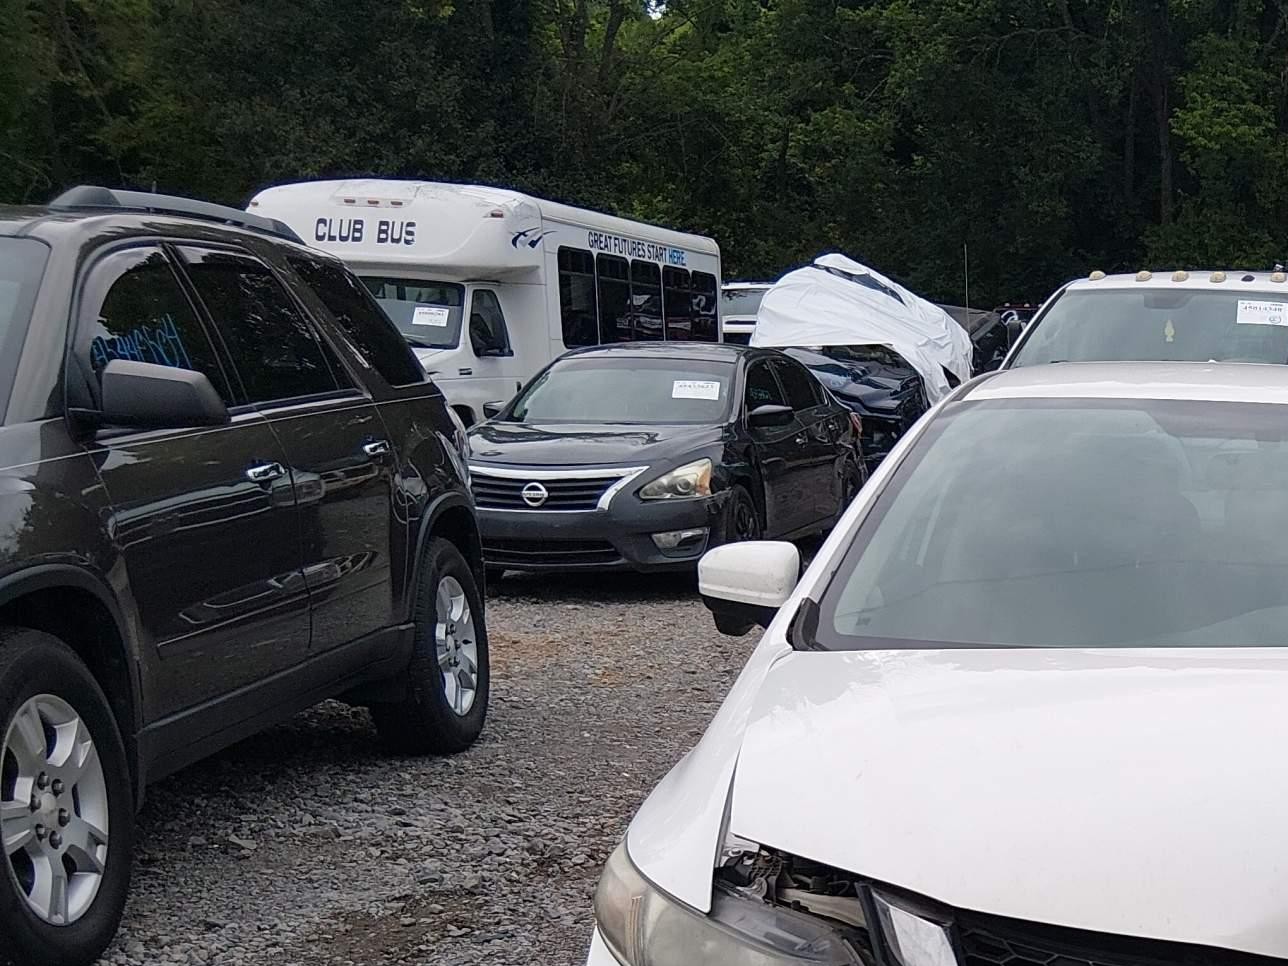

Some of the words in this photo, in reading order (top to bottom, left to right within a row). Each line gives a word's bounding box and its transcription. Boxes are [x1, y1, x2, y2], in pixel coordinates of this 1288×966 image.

[315, 218, 364, 242] CLUB
[377, 221, 416, 245] BUS
[588, 231, 613, 251] GREAT
[613, 236, 646, 259] FUTURES
[647, 243, 667, 263] START
